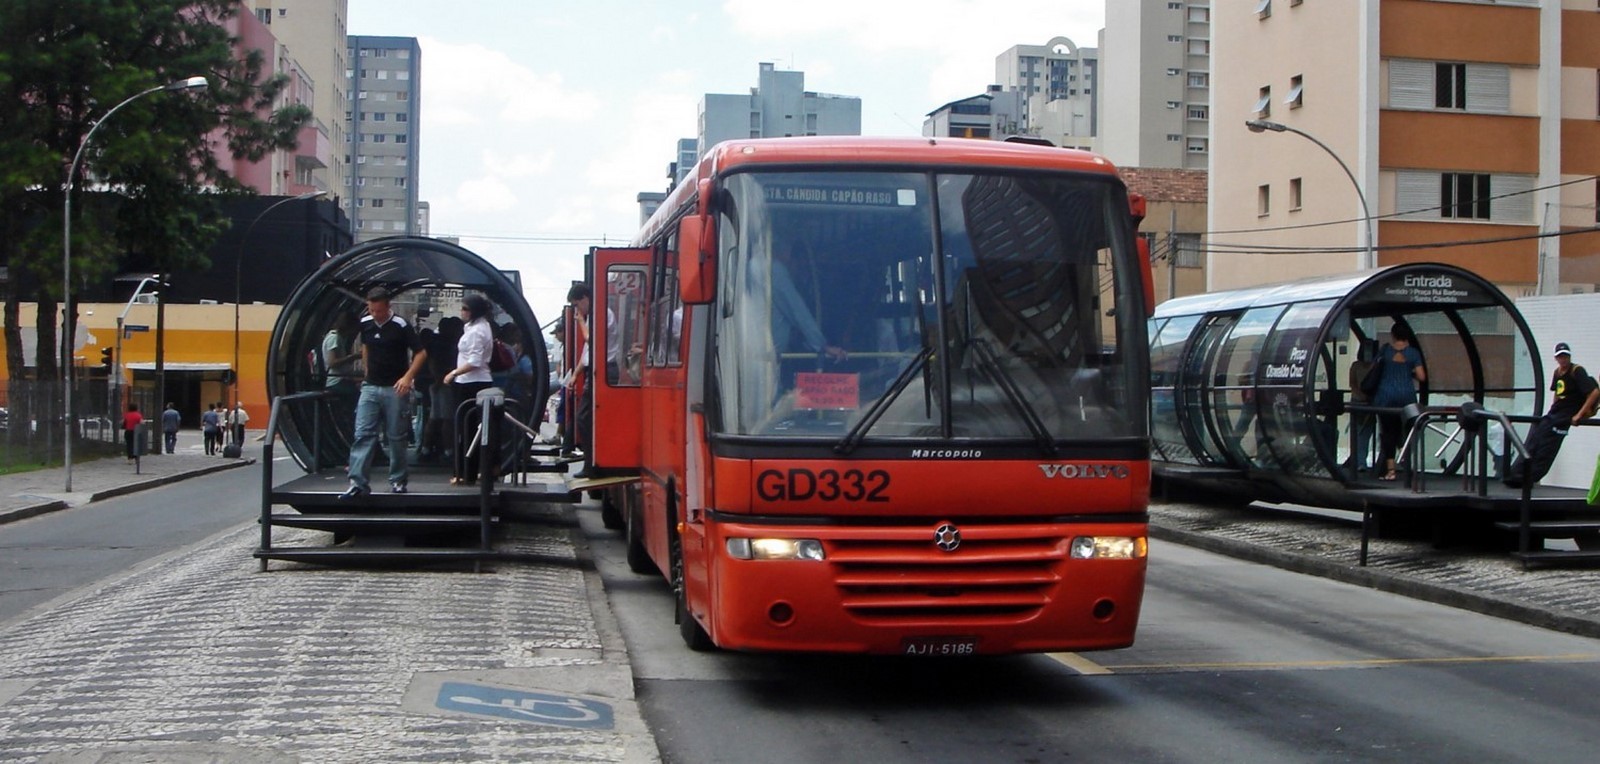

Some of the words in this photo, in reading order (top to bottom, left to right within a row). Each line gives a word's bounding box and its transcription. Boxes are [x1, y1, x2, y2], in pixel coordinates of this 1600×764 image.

[865, 191, 892, 204] RASO
[1404, 274, 1452, 288] Entrada
[1385, 287, 1408, 295] Sentido
[1443, 289, 1469, 297] Barbosa
[1265, 363, 1290, 378] Oswaldo
[1290, 363, 1304, 378] Cruz
[911, 449, 982, 458] Marcopolo
[1038, 464, 1130, 478] VOLVO
[756, 468, 891, 502] GD332
